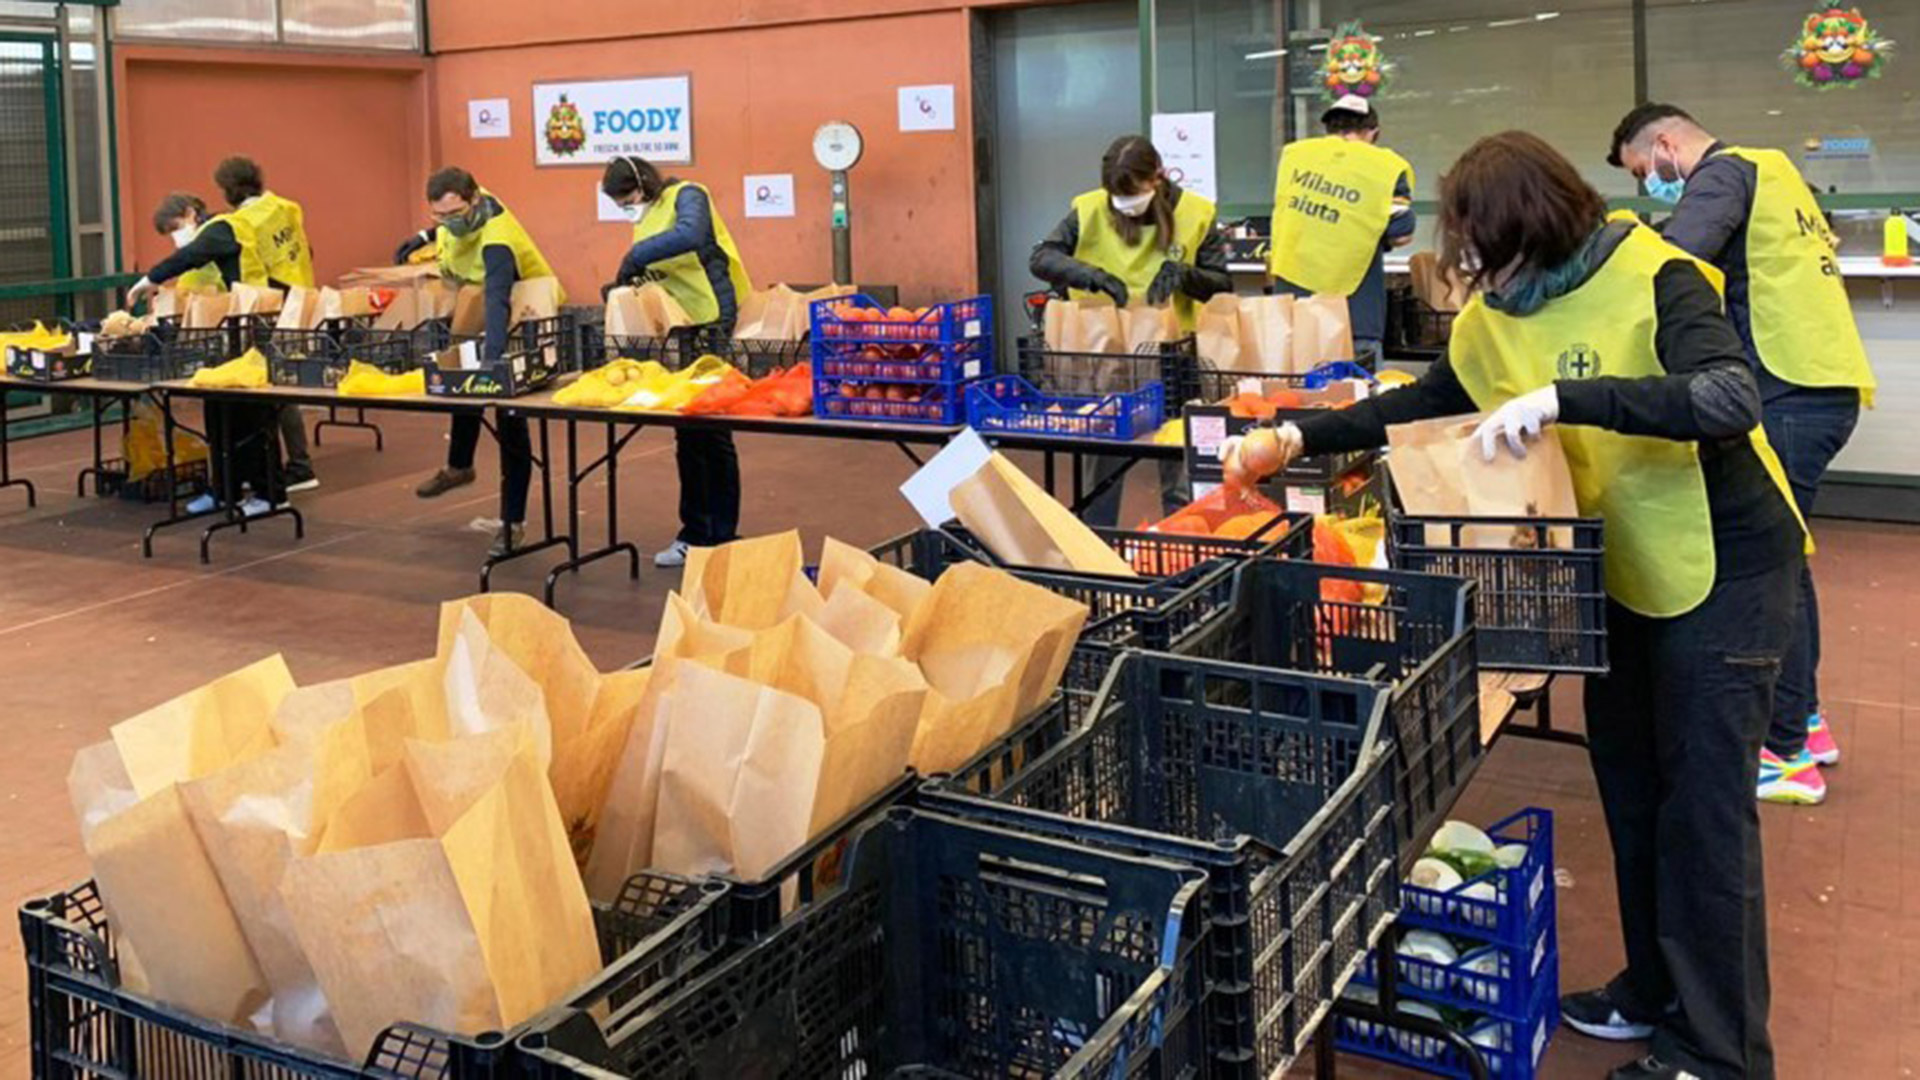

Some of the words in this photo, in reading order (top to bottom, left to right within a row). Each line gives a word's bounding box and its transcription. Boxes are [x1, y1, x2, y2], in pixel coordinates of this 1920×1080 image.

[593, 107, 681, 134] FOODY
[1290, 168, 1360, 203] Milano
[1288, 193, 1340, 224] aiuta
[451, 374, 503, 394] Amir
